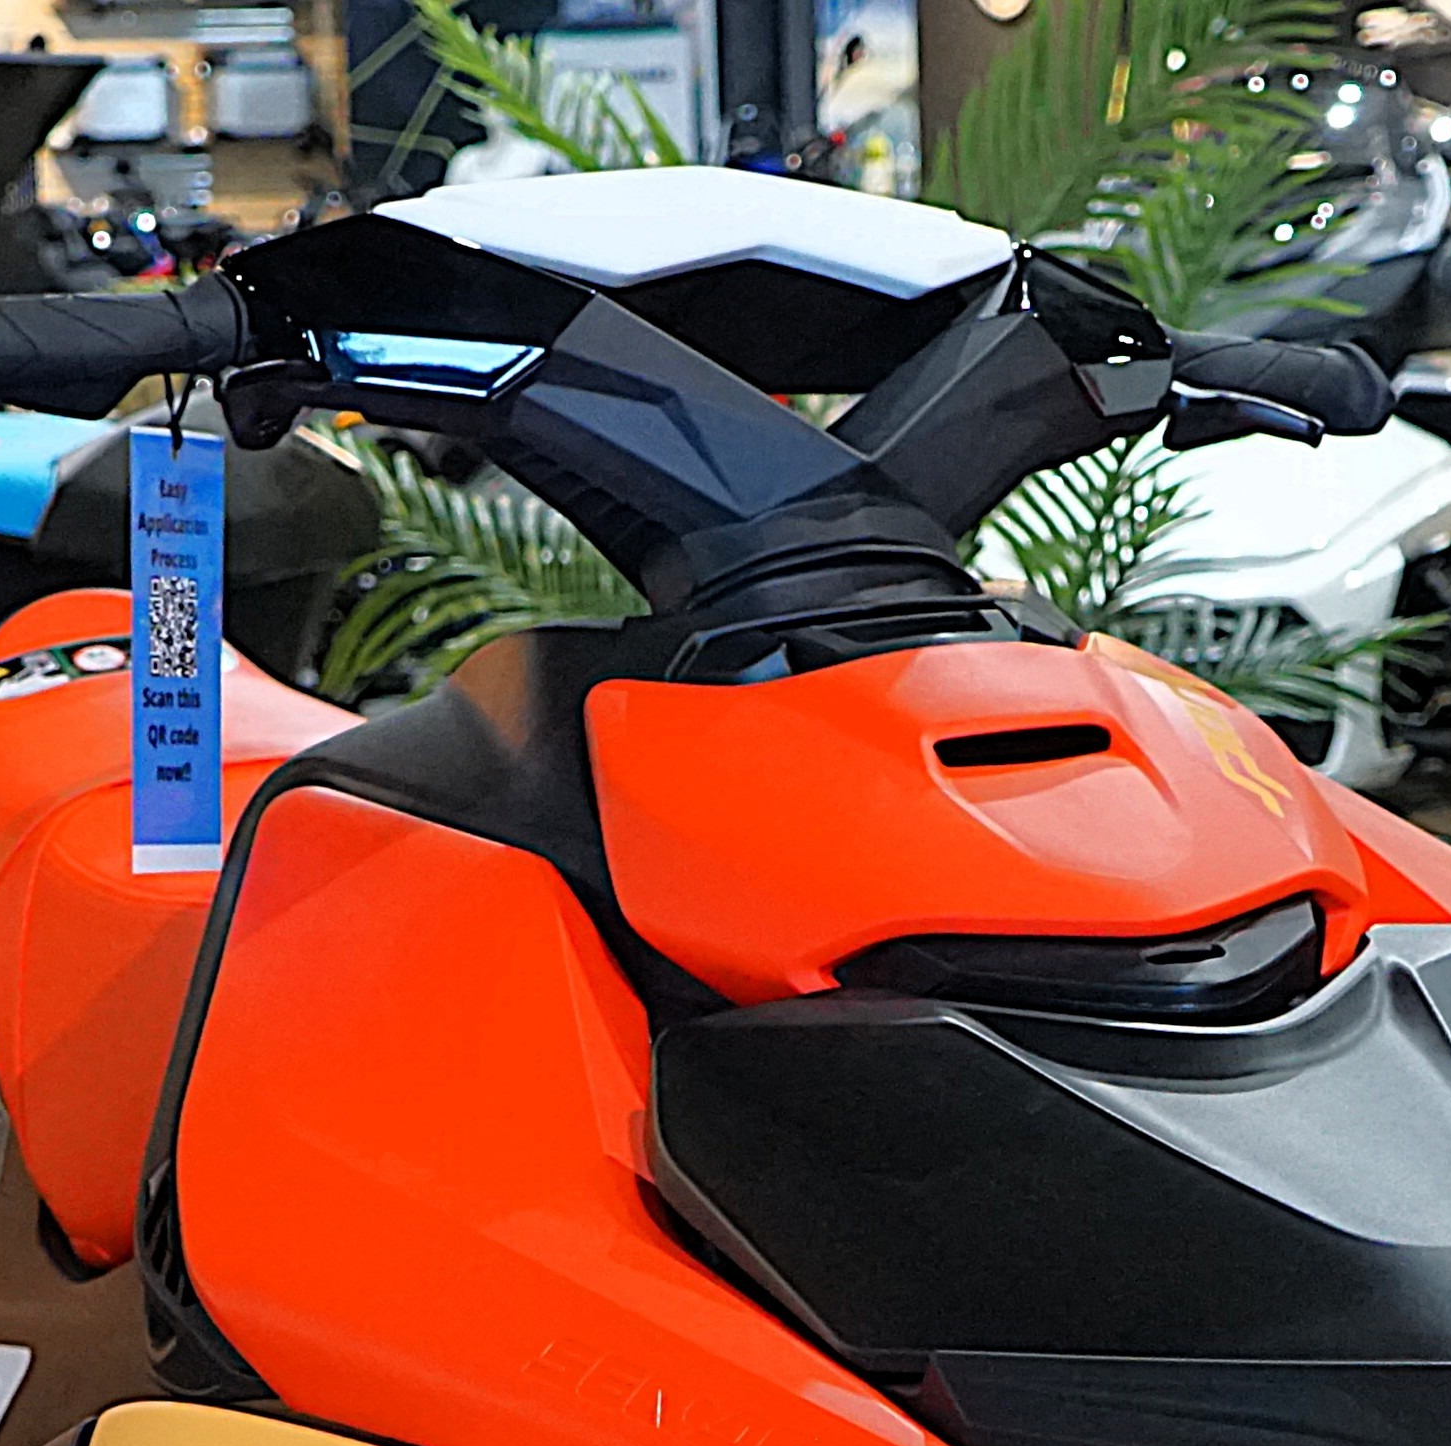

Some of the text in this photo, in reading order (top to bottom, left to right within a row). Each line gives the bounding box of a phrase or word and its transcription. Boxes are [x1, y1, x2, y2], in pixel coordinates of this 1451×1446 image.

[159, 479, 187, 504] Easy
[138, 511, 209, 537] Application
[151, 548, 198, 570] Process
[142, 686, 201, 709] Scan this
[147, 722, 200, 750] QR code
